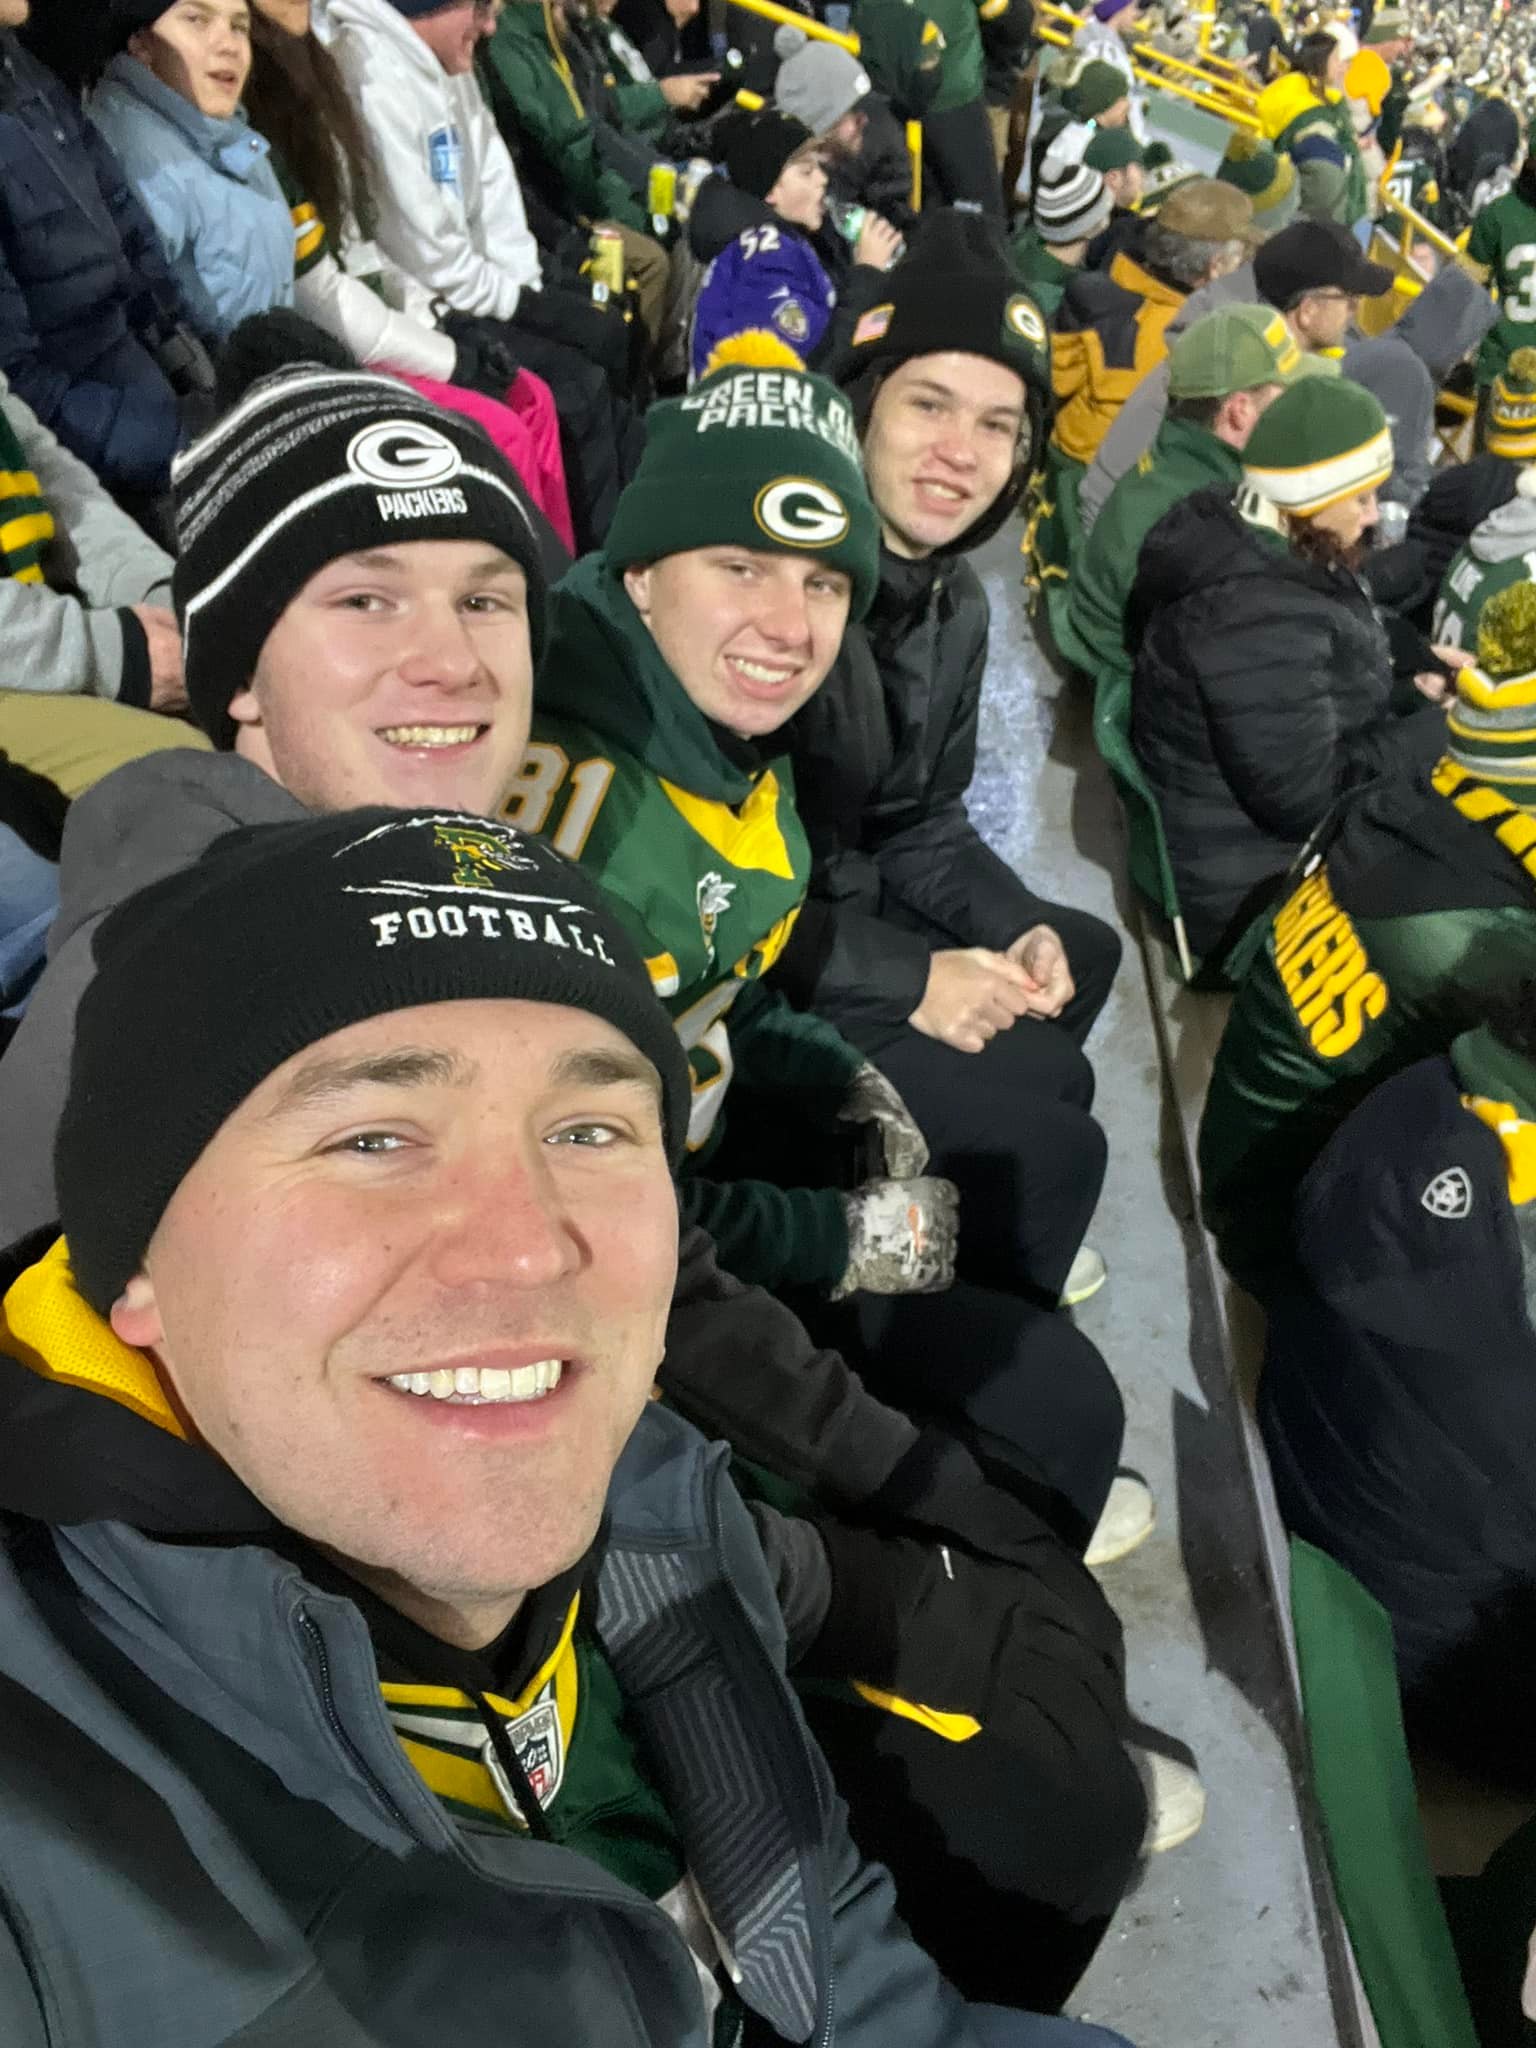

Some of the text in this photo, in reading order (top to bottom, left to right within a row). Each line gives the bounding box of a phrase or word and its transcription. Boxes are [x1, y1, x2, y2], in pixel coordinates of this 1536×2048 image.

[740, 224, 780, 260] 52
[376, 488, 468, 521] PACKERS
[497, 742, 616, 862] 81
[370, 904, 616, 967] FOOTBALL
